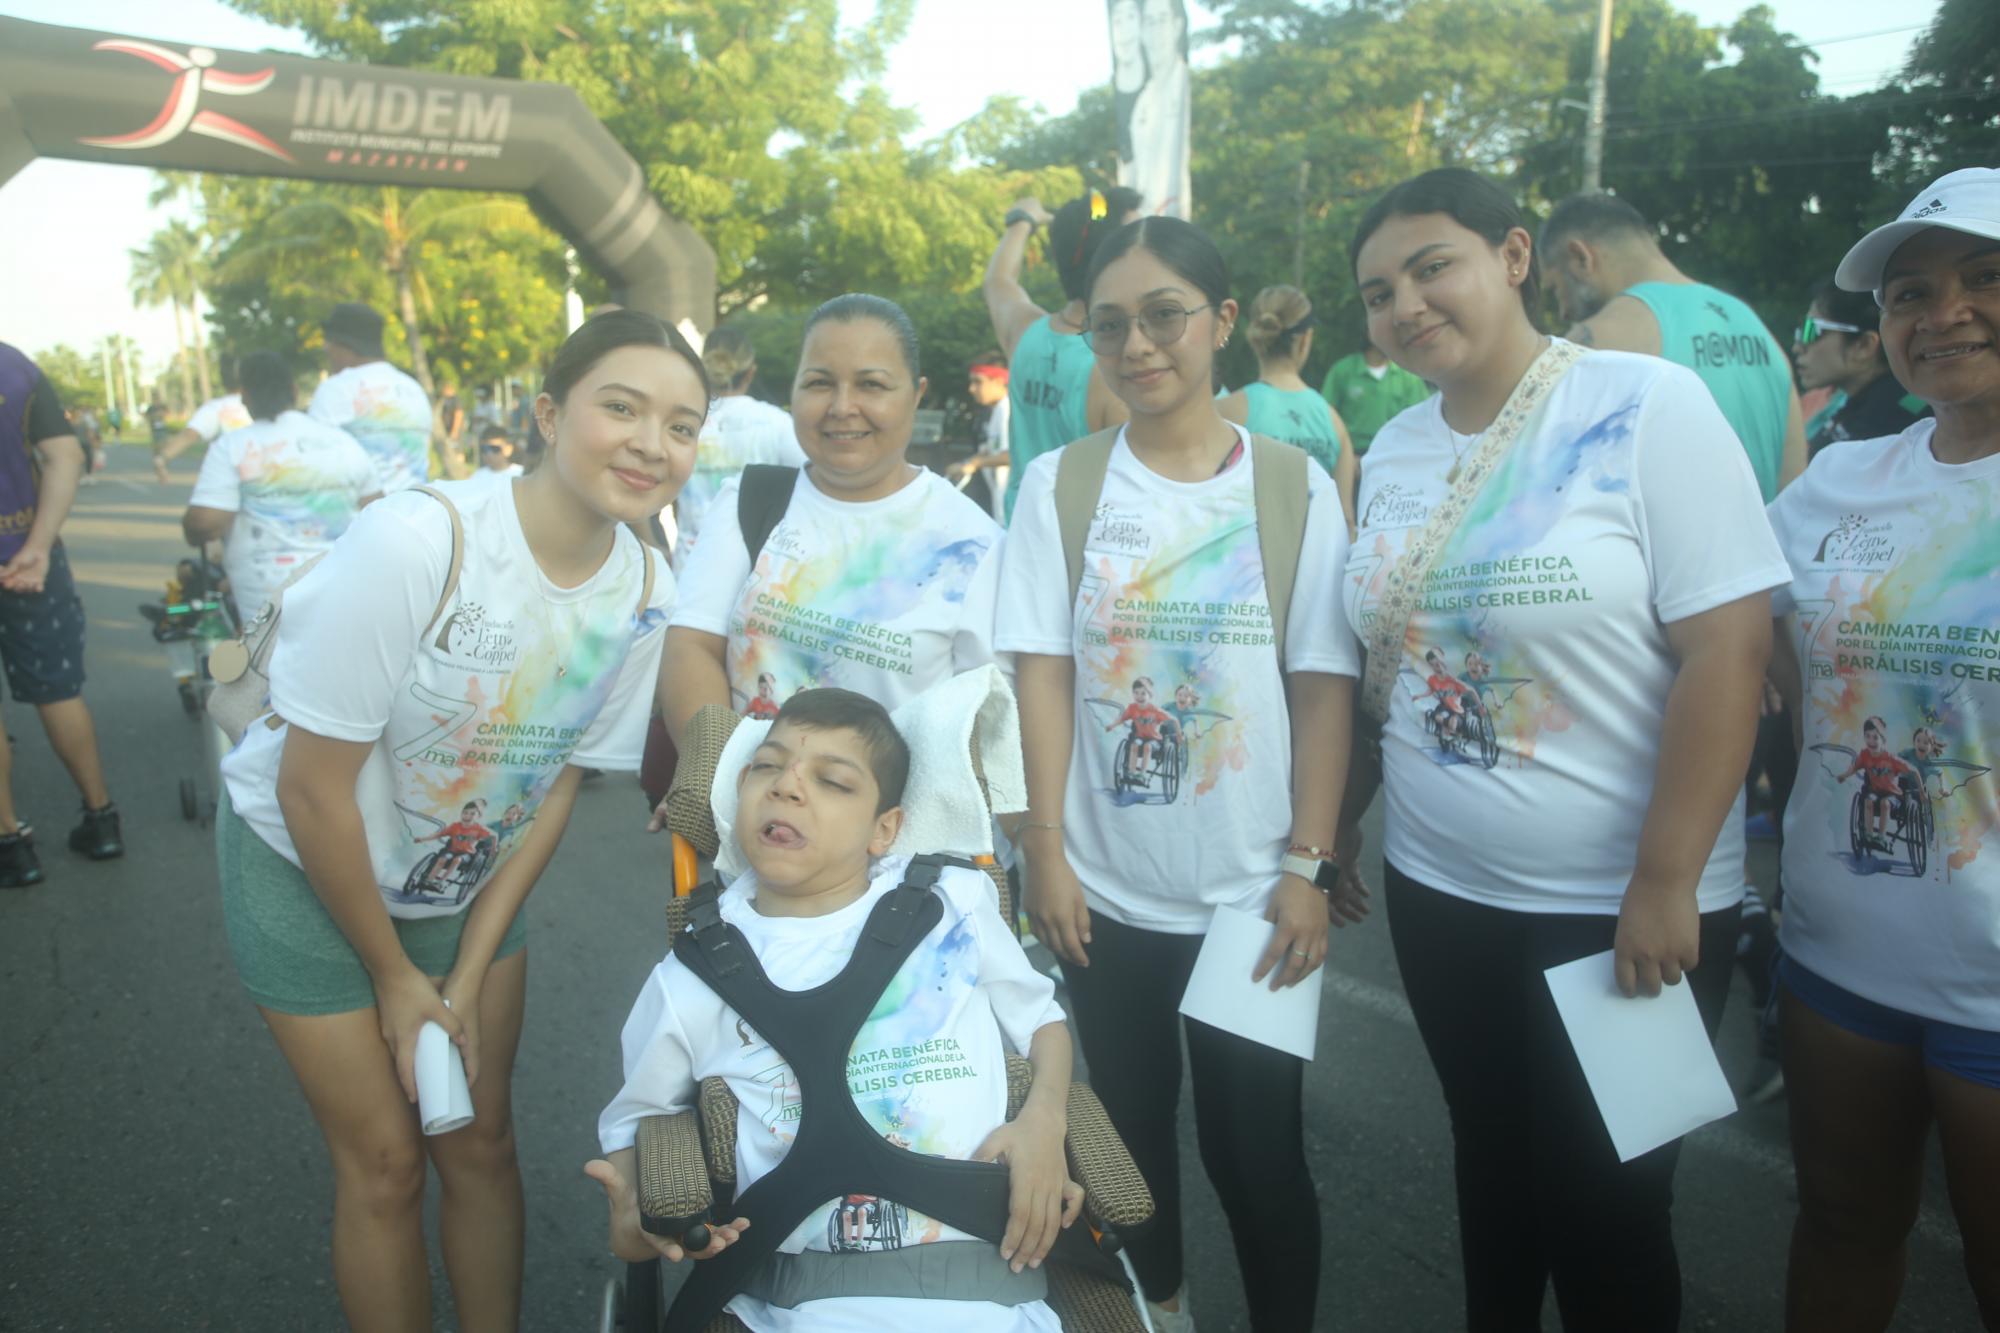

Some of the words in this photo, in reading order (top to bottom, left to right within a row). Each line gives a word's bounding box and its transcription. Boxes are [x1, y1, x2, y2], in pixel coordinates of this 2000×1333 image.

[293, 74, 512, 142] IMDEM
[1102, 530, 1150, 550] Coppel
[1470, 555, 1573, 576] BENÉFICA
[1841, 546, 1894, 566] Coppel
[1443, 574, 1535, 591] INTERNACIONAL
[1537, 573, 1557, 583] DE
[1560, 572, 1579, 582] LA
[1114, 599, 1201, 614] CAMINATA
[1476, 587, 1593, 608] CEREBRAL
[757, 592, 832, 625] CAMINATA
[835, 616, 912, 648] BENÉFICA
[1112, 613, 1135, 622] POR
[1136, 614, 1149, 623] EL
[1151, 613, 1170, 624] DÍA
[1171, 617, 1255, 628] INTERNACIONAL
[1838, 621, 1941, 639] CAMINATA
[752, 606, 770, 619] POR
[772, 611, 784, 622] EL
[786, 614, 802, 628] DÍA
[804, 621, 882, 652] INTERNACIONAL
[885, 645, 899, 656] DE
[900, 648, 912, 659] LA
[1110, 625, 1203, 642] PARÁLISIS
[473, 645, 517, 666] Coppel
[747, 618, 829, 652] PARÁLISIS
[833, 643, 913, 675] CEREBRAL
[1836, 638, 1860, 649] POR
[1863, 639, 1877, 649] EL
[1880, 637, 1901, 652] DÍA
[1903, 641, 2000, 660] INTERNACIO
[1811, 662, 1833, 677] ma
[1838, 653, 1943, 676] PARÁLISIS
[476, 723, 555, 738] CAMINATA
[471, 737, 494, 747] POR
[495, 738, 506, 748] EL
[508, 737, 524, 748] DÍA
[424, 749, 456, 767] ma
[463, 749, 549, 766] PARÁLISIS
[892, 1039, 960, 1059] BENÉFICA
[863, 1056, 944, 1075] INTERNACIONAL
[945, 1054, 955, 1062] DE
[956, 1053, 967, 1062] LA
[902, 1066, 978, 1086] CEREBRAL
